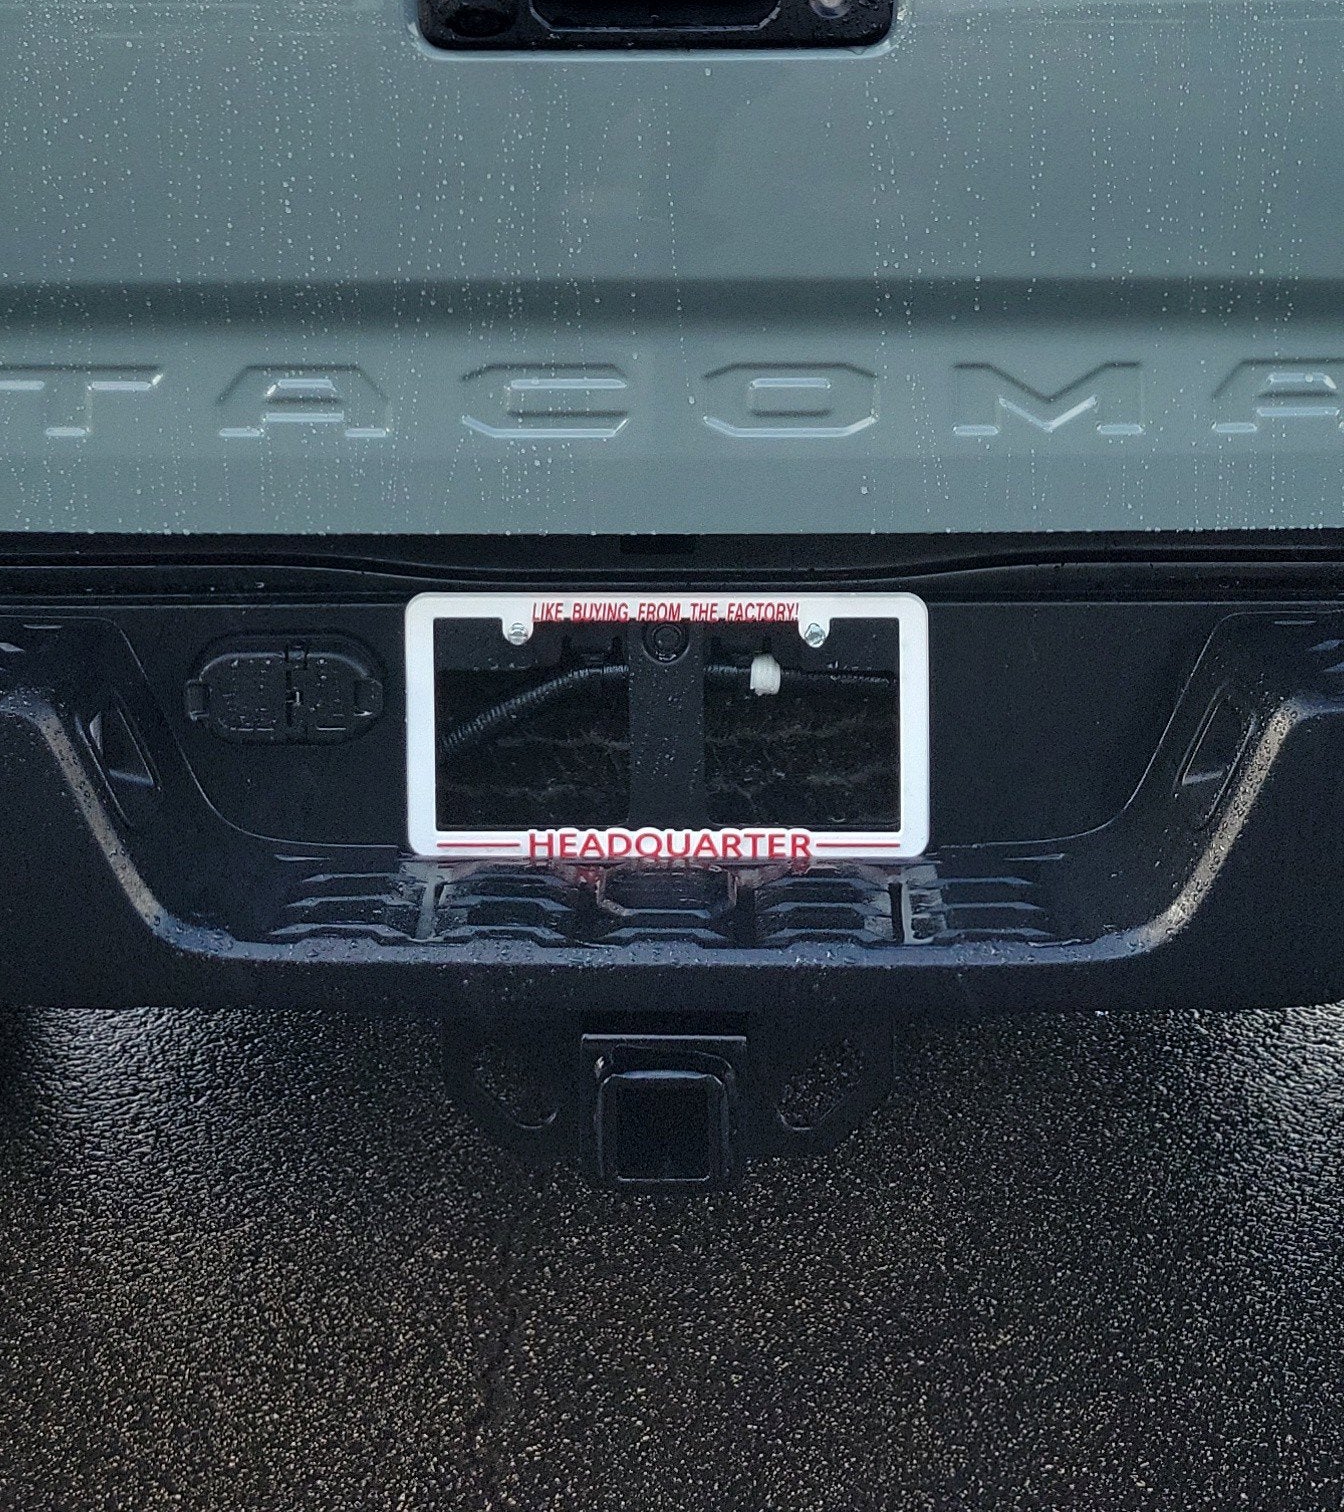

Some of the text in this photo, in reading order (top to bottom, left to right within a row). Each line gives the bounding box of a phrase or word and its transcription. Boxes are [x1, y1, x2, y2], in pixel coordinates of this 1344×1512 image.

[532, 601, 800, 622] LIKE BUYING FROM THE FACTORY!
[528, 832, 812, 859] HEADQUARTER
